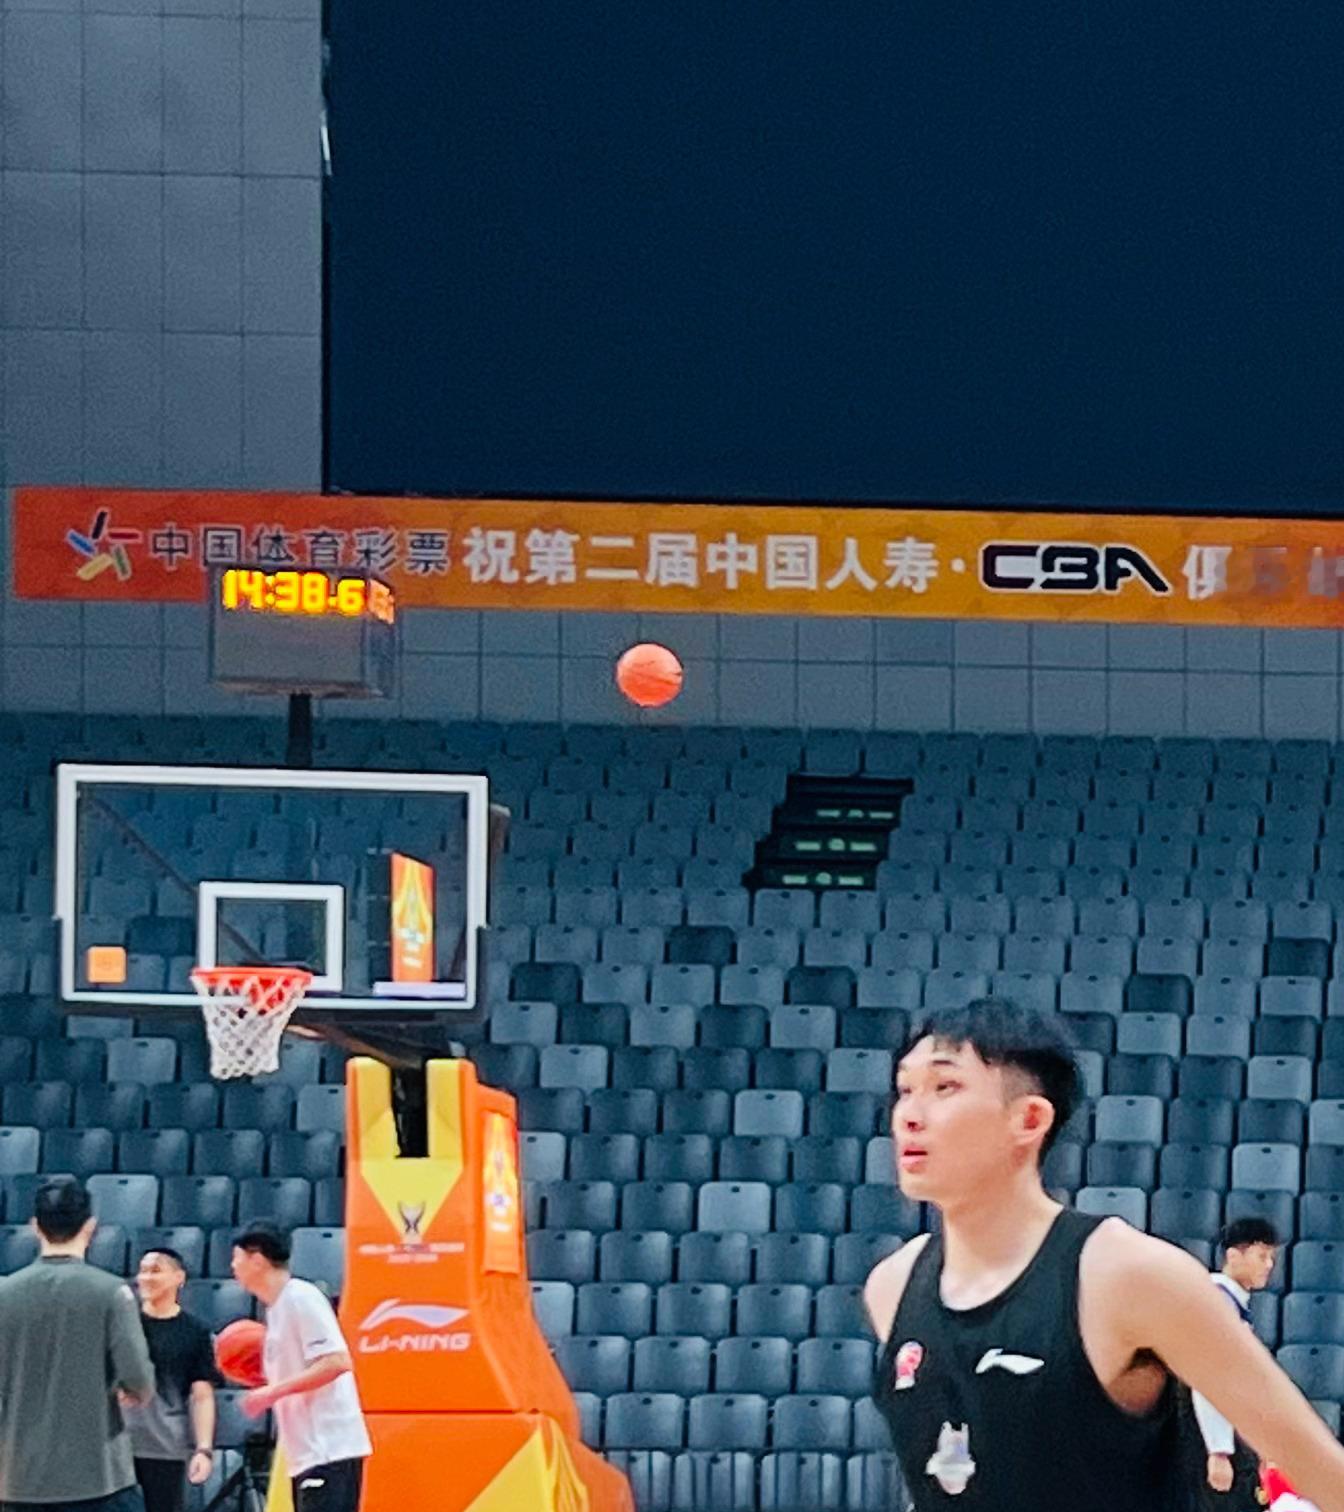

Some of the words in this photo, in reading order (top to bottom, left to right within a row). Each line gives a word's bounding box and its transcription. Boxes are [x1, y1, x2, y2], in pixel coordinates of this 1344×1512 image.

[152, 525, 450, 573] 中国体育彩票
[223, 568, 366, 616] 14:38.6
[359, 1333, 471, 1354] LI-NING
